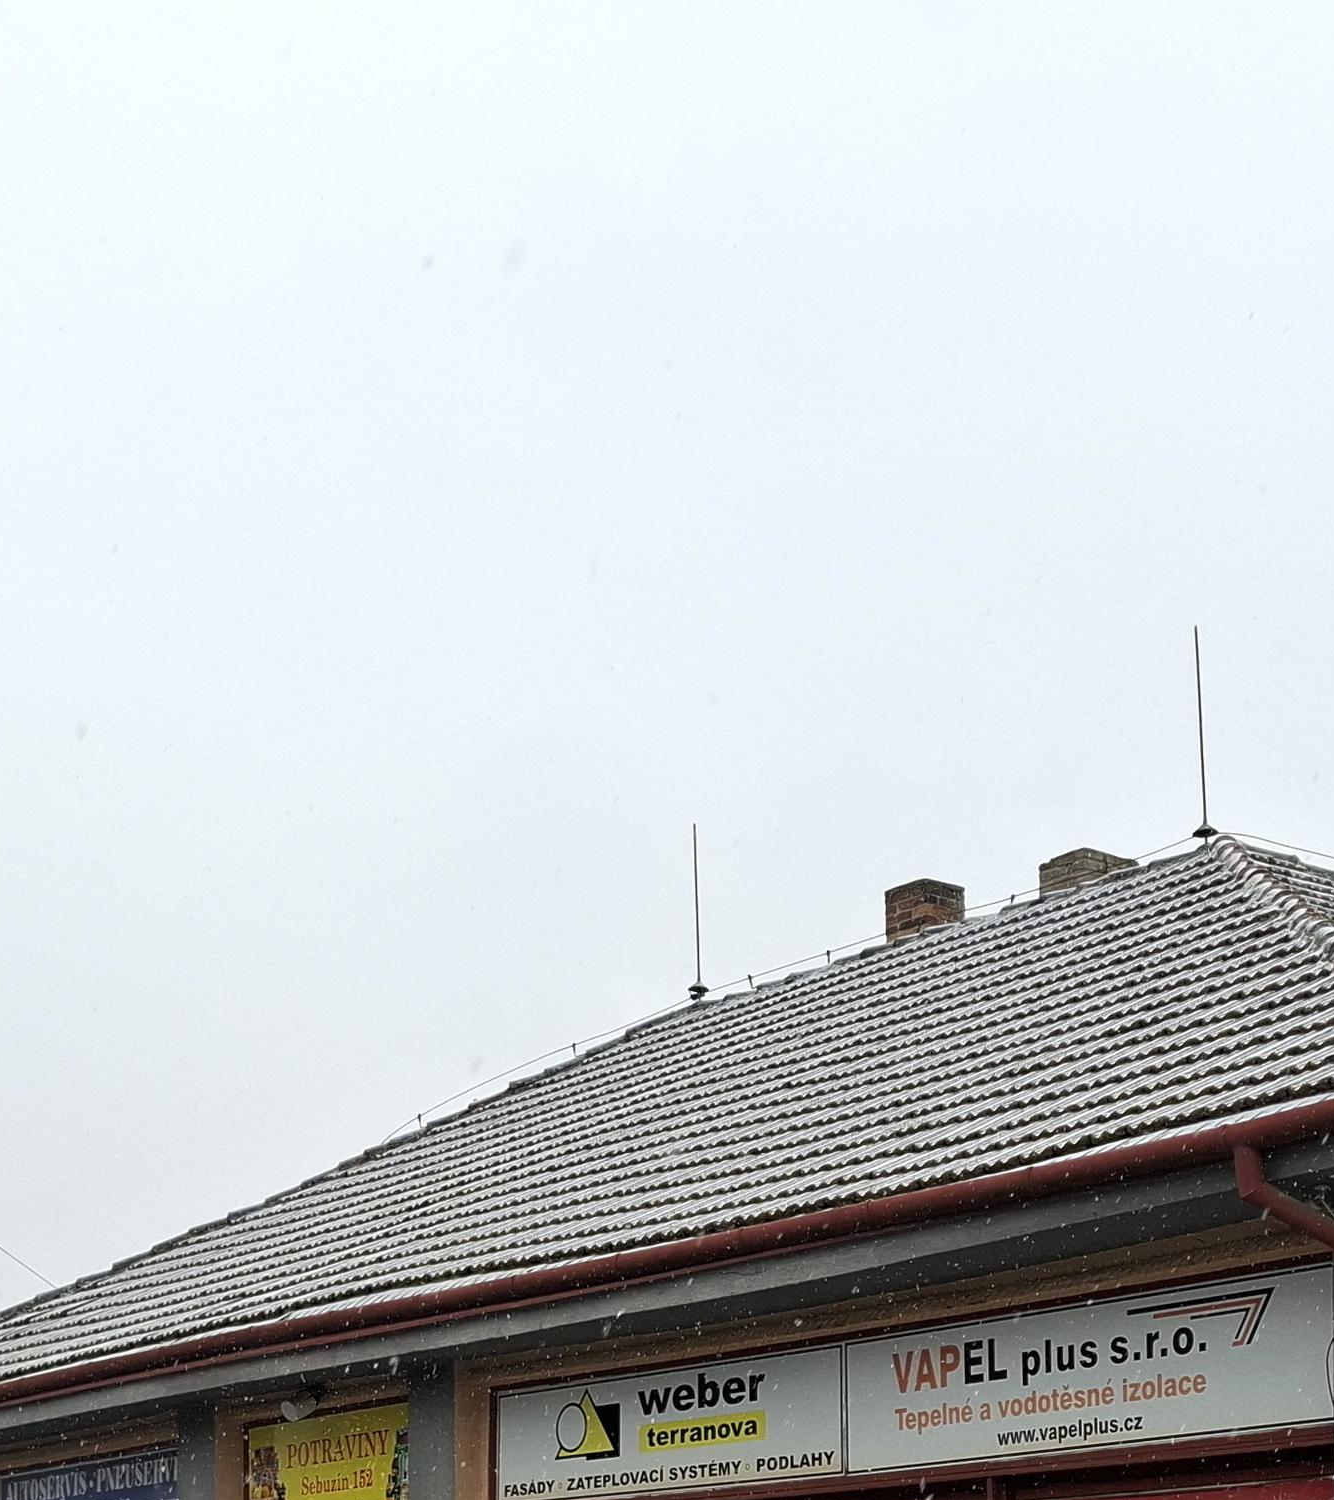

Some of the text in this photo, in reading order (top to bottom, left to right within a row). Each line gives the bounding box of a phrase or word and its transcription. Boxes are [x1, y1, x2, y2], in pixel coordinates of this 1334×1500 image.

[891, 1325, 1208, 1395] VAPEL plus s.r.o.
[637, 1372, 766, 1416] weber
[894, 1372, 1208, 1435] Tepelné a vodotěsné izolace
[286, 1429, 390, 1468] POTRAVINY
[647, 1417, 758, 1448] terranova
[997, 1414, 1143, 1447] www.vapelplus.cz
[96, 1456, 178, 1492] PNEUSERVI
[301, 1468, 374, 1496] Sebuzín 152
[504, 1450, 835, 1498] FASÁDY ZATEPLOVACÍ SYSTÉMY PODLAHY
